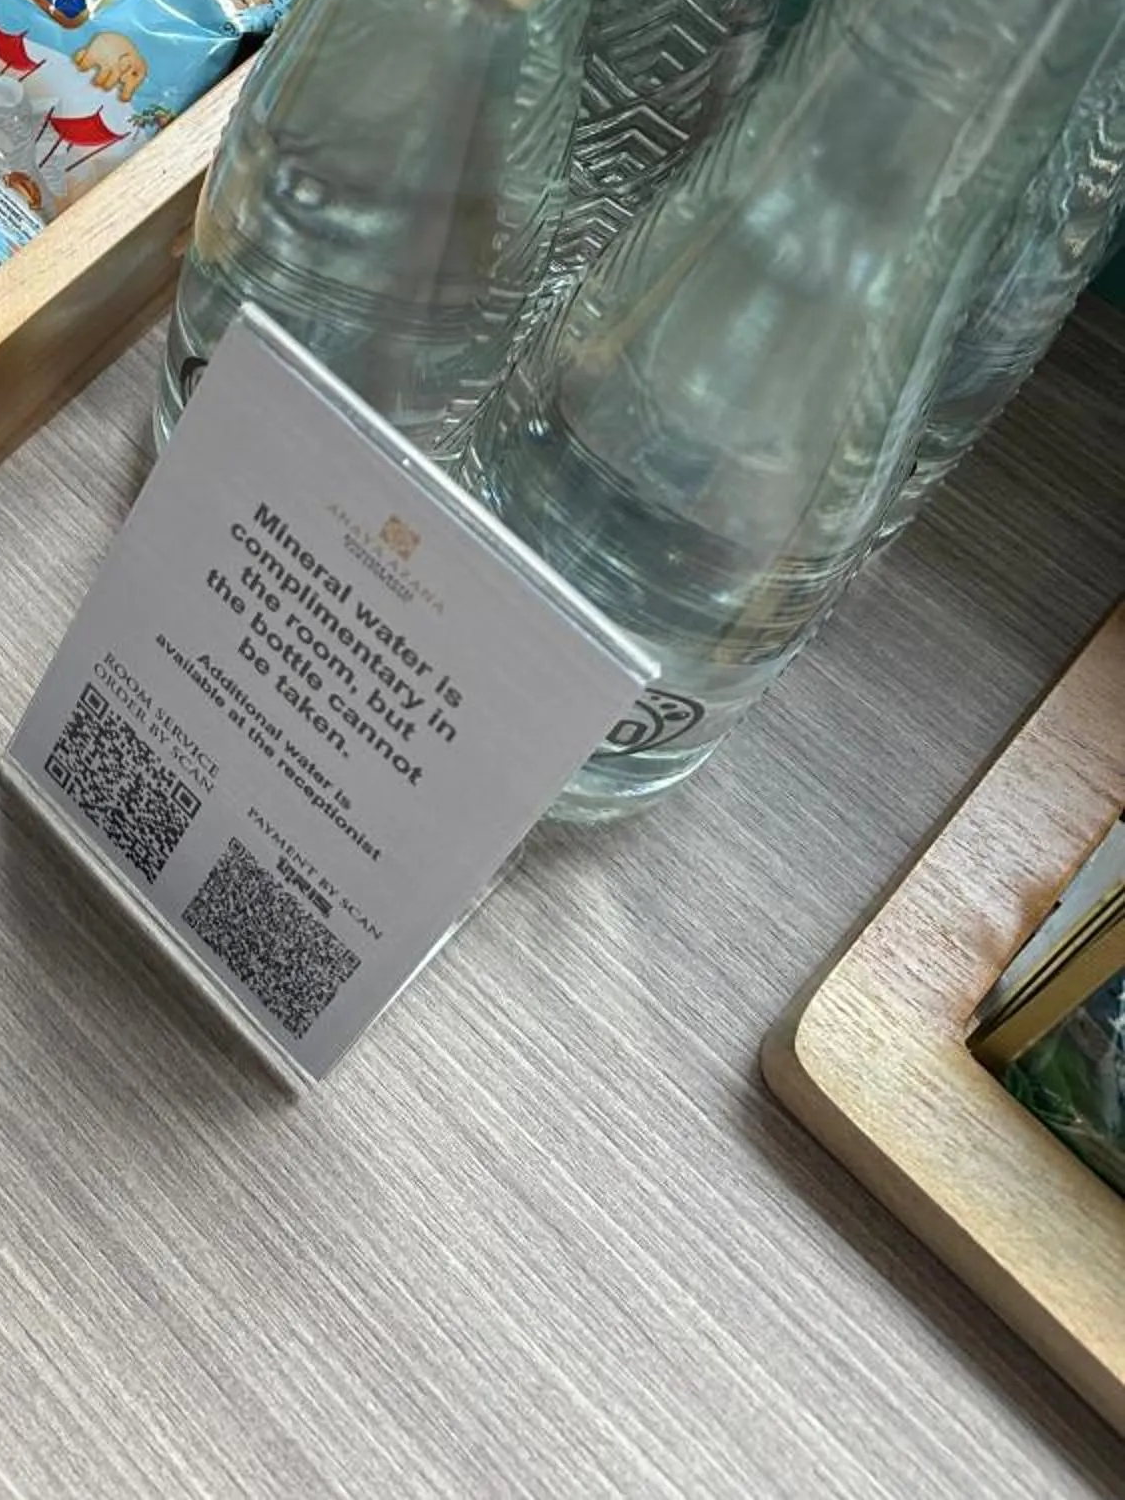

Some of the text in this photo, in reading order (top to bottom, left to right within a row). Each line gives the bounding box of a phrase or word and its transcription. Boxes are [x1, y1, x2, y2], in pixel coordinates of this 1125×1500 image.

[206, 568, 425, 788] the bottle cannot
[230, 522, 426, 711] complimentary
[426, 707, 458, 743] in
[240, 566, 281, 613] the
[285, 613, 359, 695] room,
[366, 687, 417, 742] but
[253, 501, 353, 604] Mineral
[355, 600, 434, 677] water
[434, 675, 464, 709] is
[93, 662, 215, 795] ORDER BY SCAN
[103, 651, 220, 778] ROOM SERVICE
[155, 633, 383, 863] available at the receptionist
[195, 653, 352, 811] Additional water is
[237, 635, 351, 759] be taken.
[247, 806, 384, 940] PAYMENT BY SCAN
